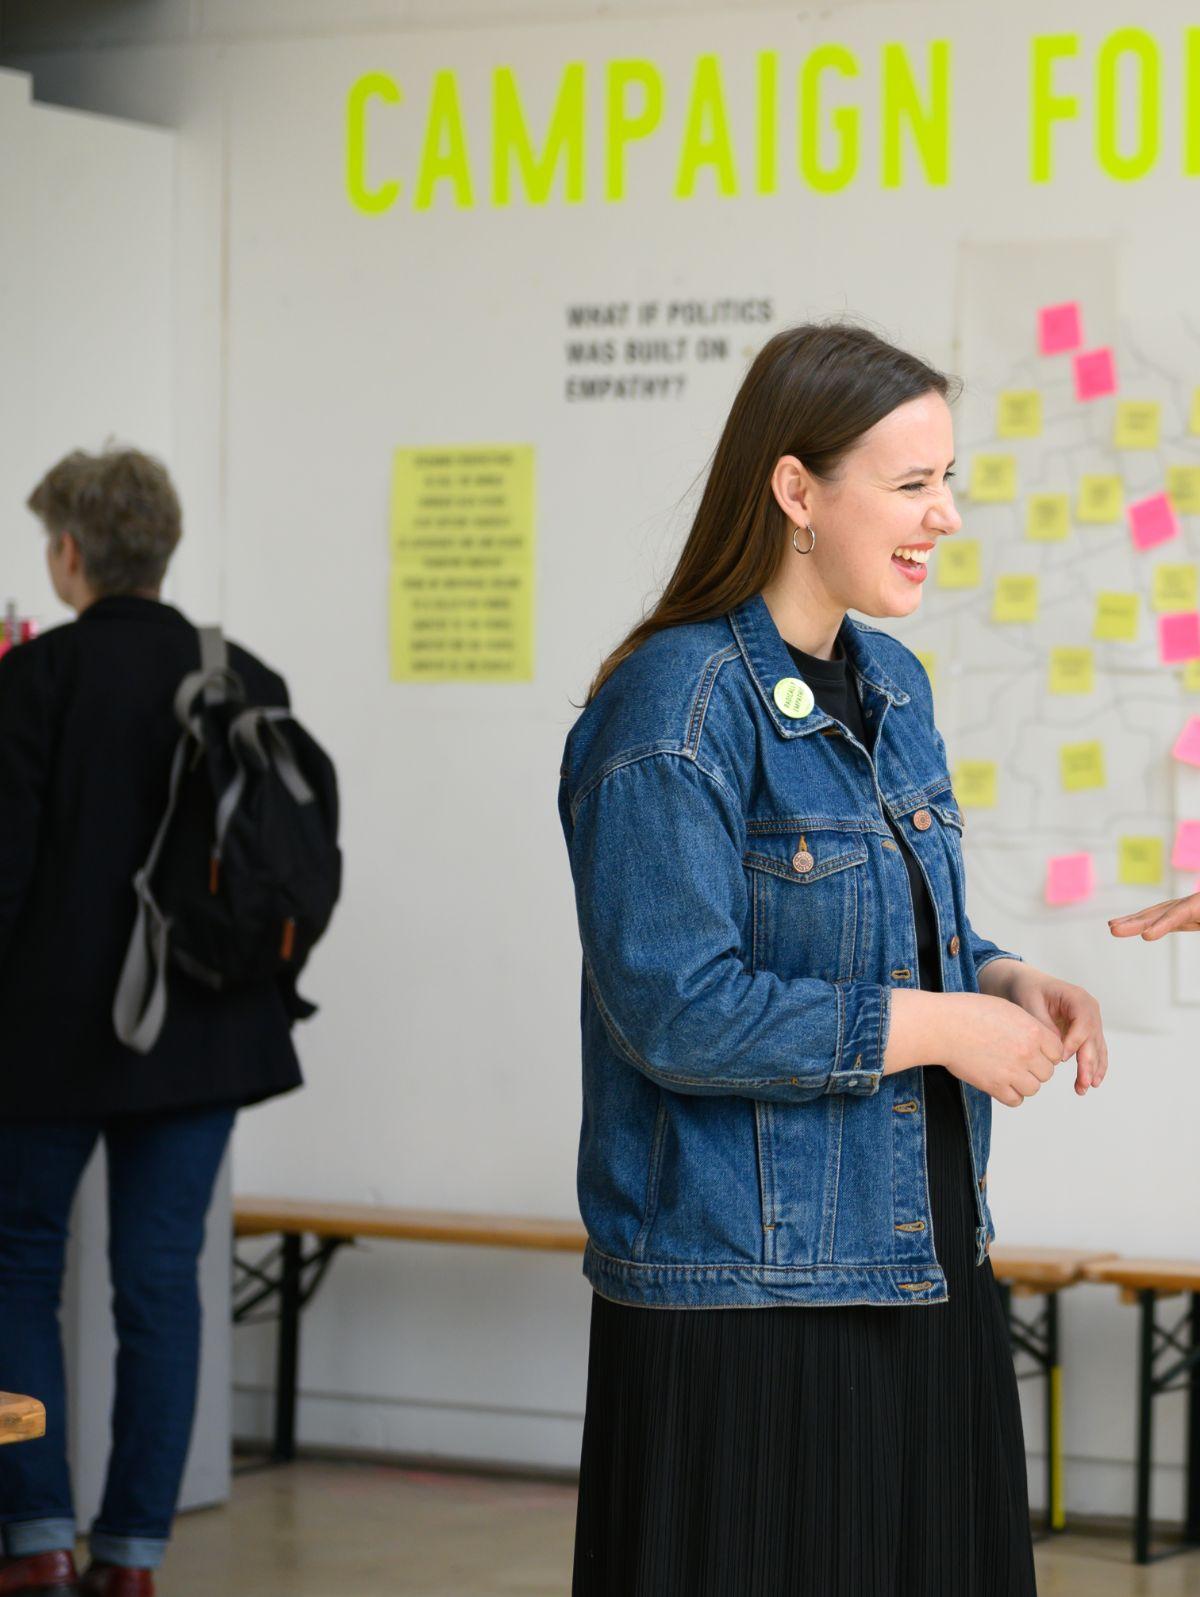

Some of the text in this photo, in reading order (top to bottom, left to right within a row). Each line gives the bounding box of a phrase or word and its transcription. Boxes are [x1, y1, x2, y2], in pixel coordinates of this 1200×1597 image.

[346, 39, 951, 215] CAMPAIGN
[566, 299, 772, 326] WHAT IF POLITICS
[566, 338, 727, 363] WAS BUILT ON
[566, 374, 687, 400] EMPATHY?
